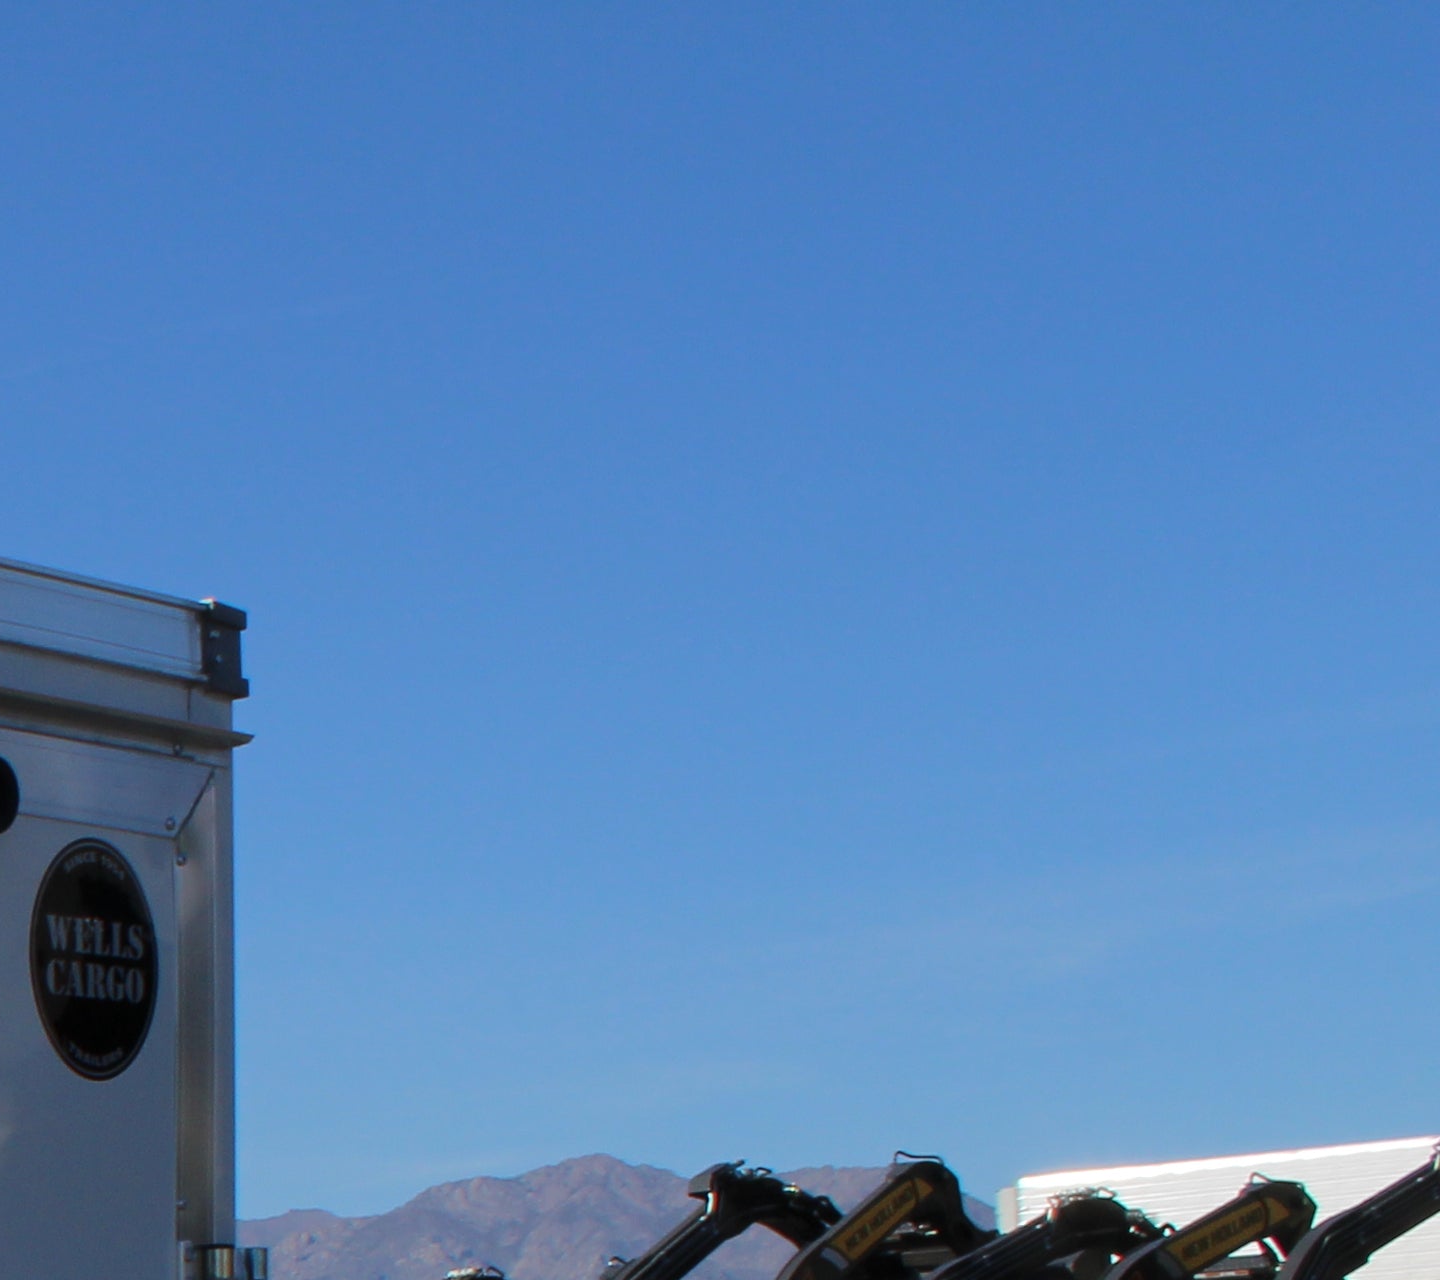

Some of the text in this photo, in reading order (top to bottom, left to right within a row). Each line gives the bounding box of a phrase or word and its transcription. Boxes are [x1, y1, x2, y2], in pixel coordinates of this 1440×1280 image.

[45, 914, 145, 961] WELLS
[45, 960, 145, 1005] CARGO
[845, 1185, 915, 1251] NEW HOLLAND
[1211, 1205, 1266, 1240] HOLLAND
